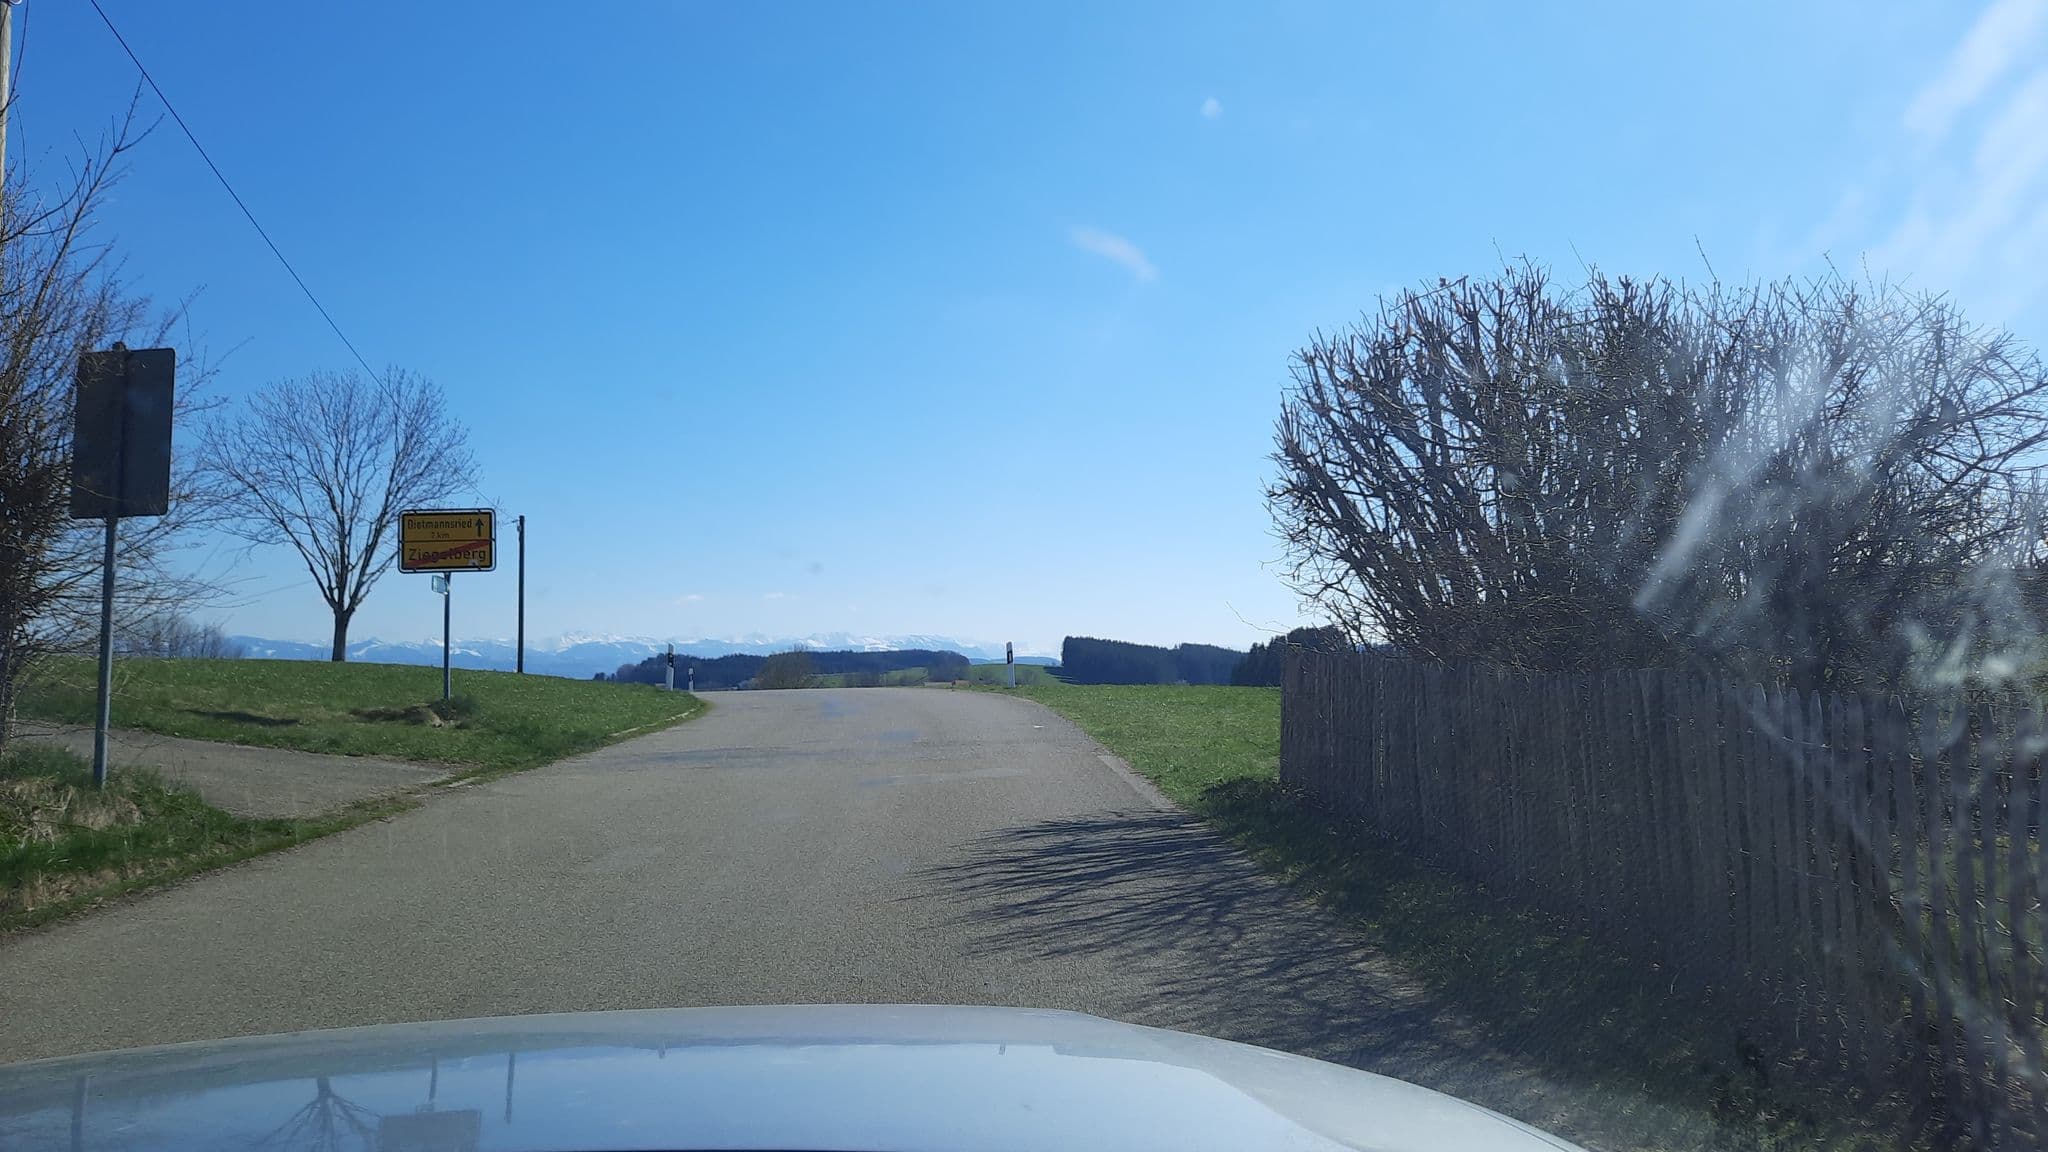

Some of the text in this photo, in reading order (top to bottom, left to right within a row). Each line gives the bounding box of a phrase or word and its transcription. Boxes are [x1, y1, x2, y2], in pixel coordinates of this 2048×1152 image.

[407, 518, 473, 530] Dietmannsried
[437, 531, 450, 539] km
[408, 548, 486, 563] Ziegelberg
